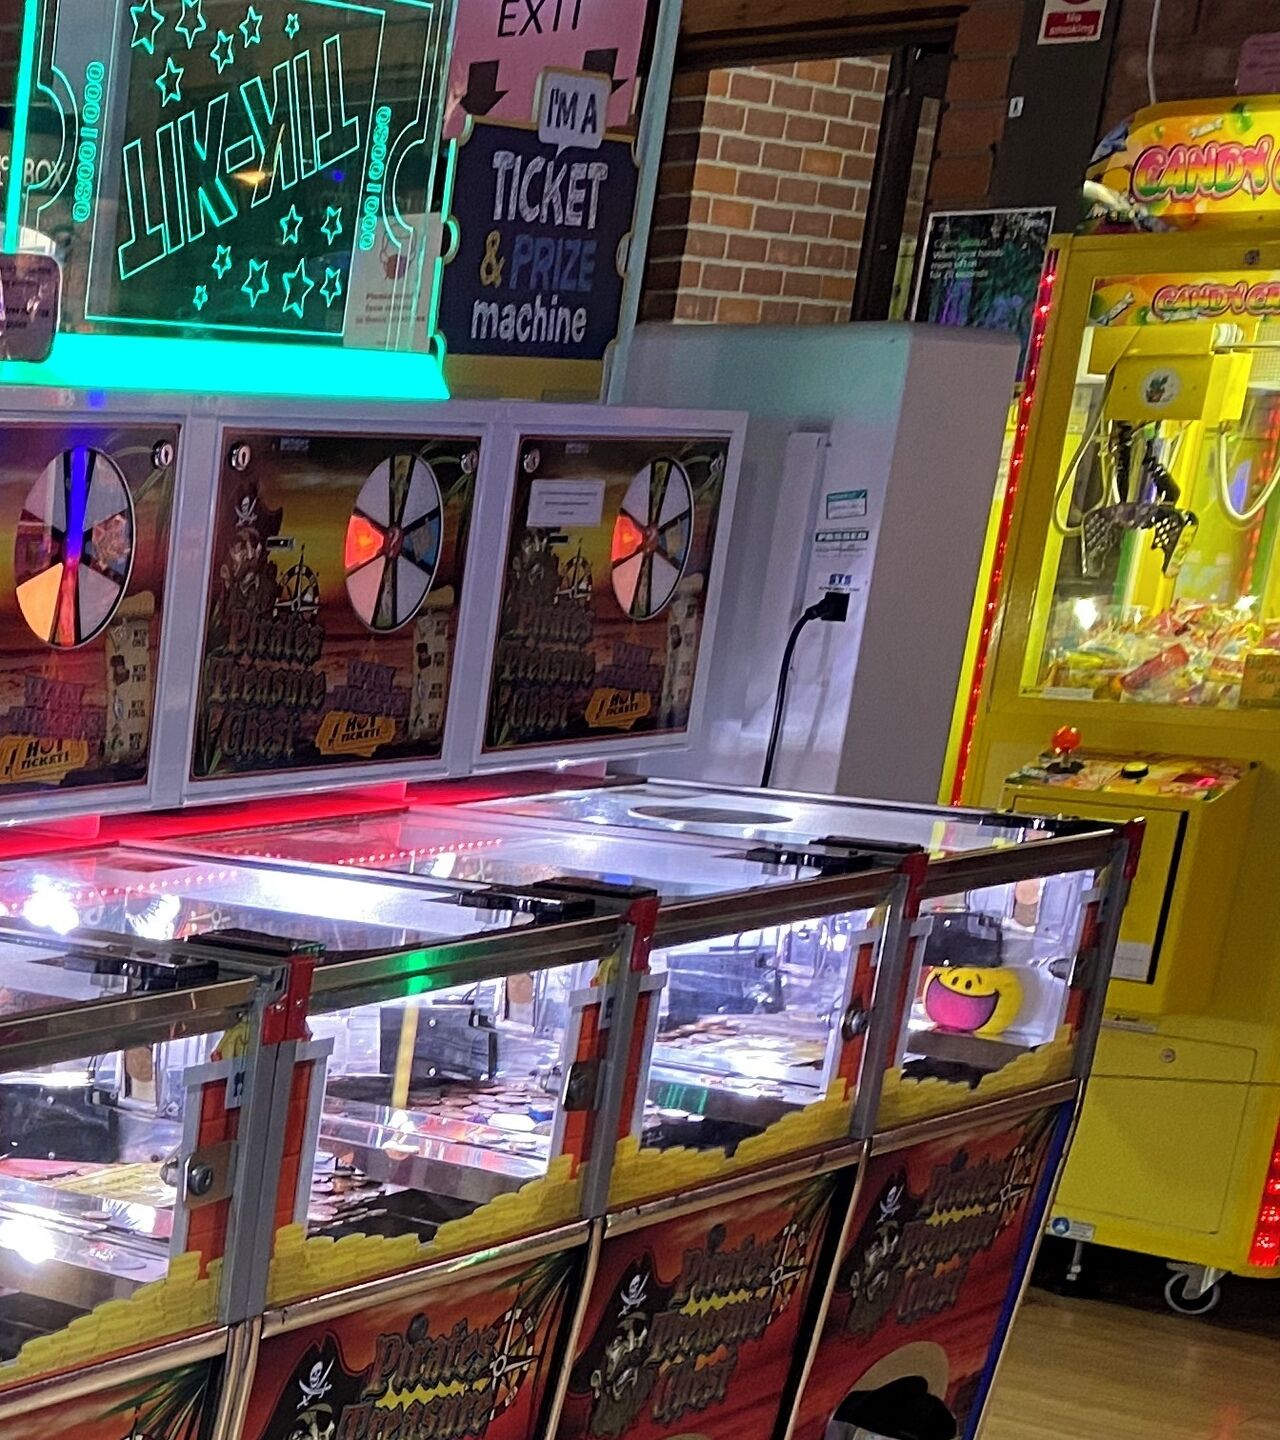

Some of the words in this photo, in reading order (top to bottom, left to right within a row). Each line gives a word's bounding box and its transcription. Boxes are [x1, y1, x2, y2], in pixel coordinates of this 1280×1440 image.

[497, 0, 583, 38] EXIT
[546, 87, 576, 129] I'M
[580, 94, 598, 134] A
[24, 158, 67, 190] BOX
[492, 150, 609, 230] TICKET
[1130, 134, 1274, 202] CANDY
[479, 230, 506, 288] &
[509, 234, 598, 292] PRIZE
[470, 293, 588, 344] machine
[1152, 280, 1249, 319] CANDY
[360, 1318, 499, 1405] Pirates
